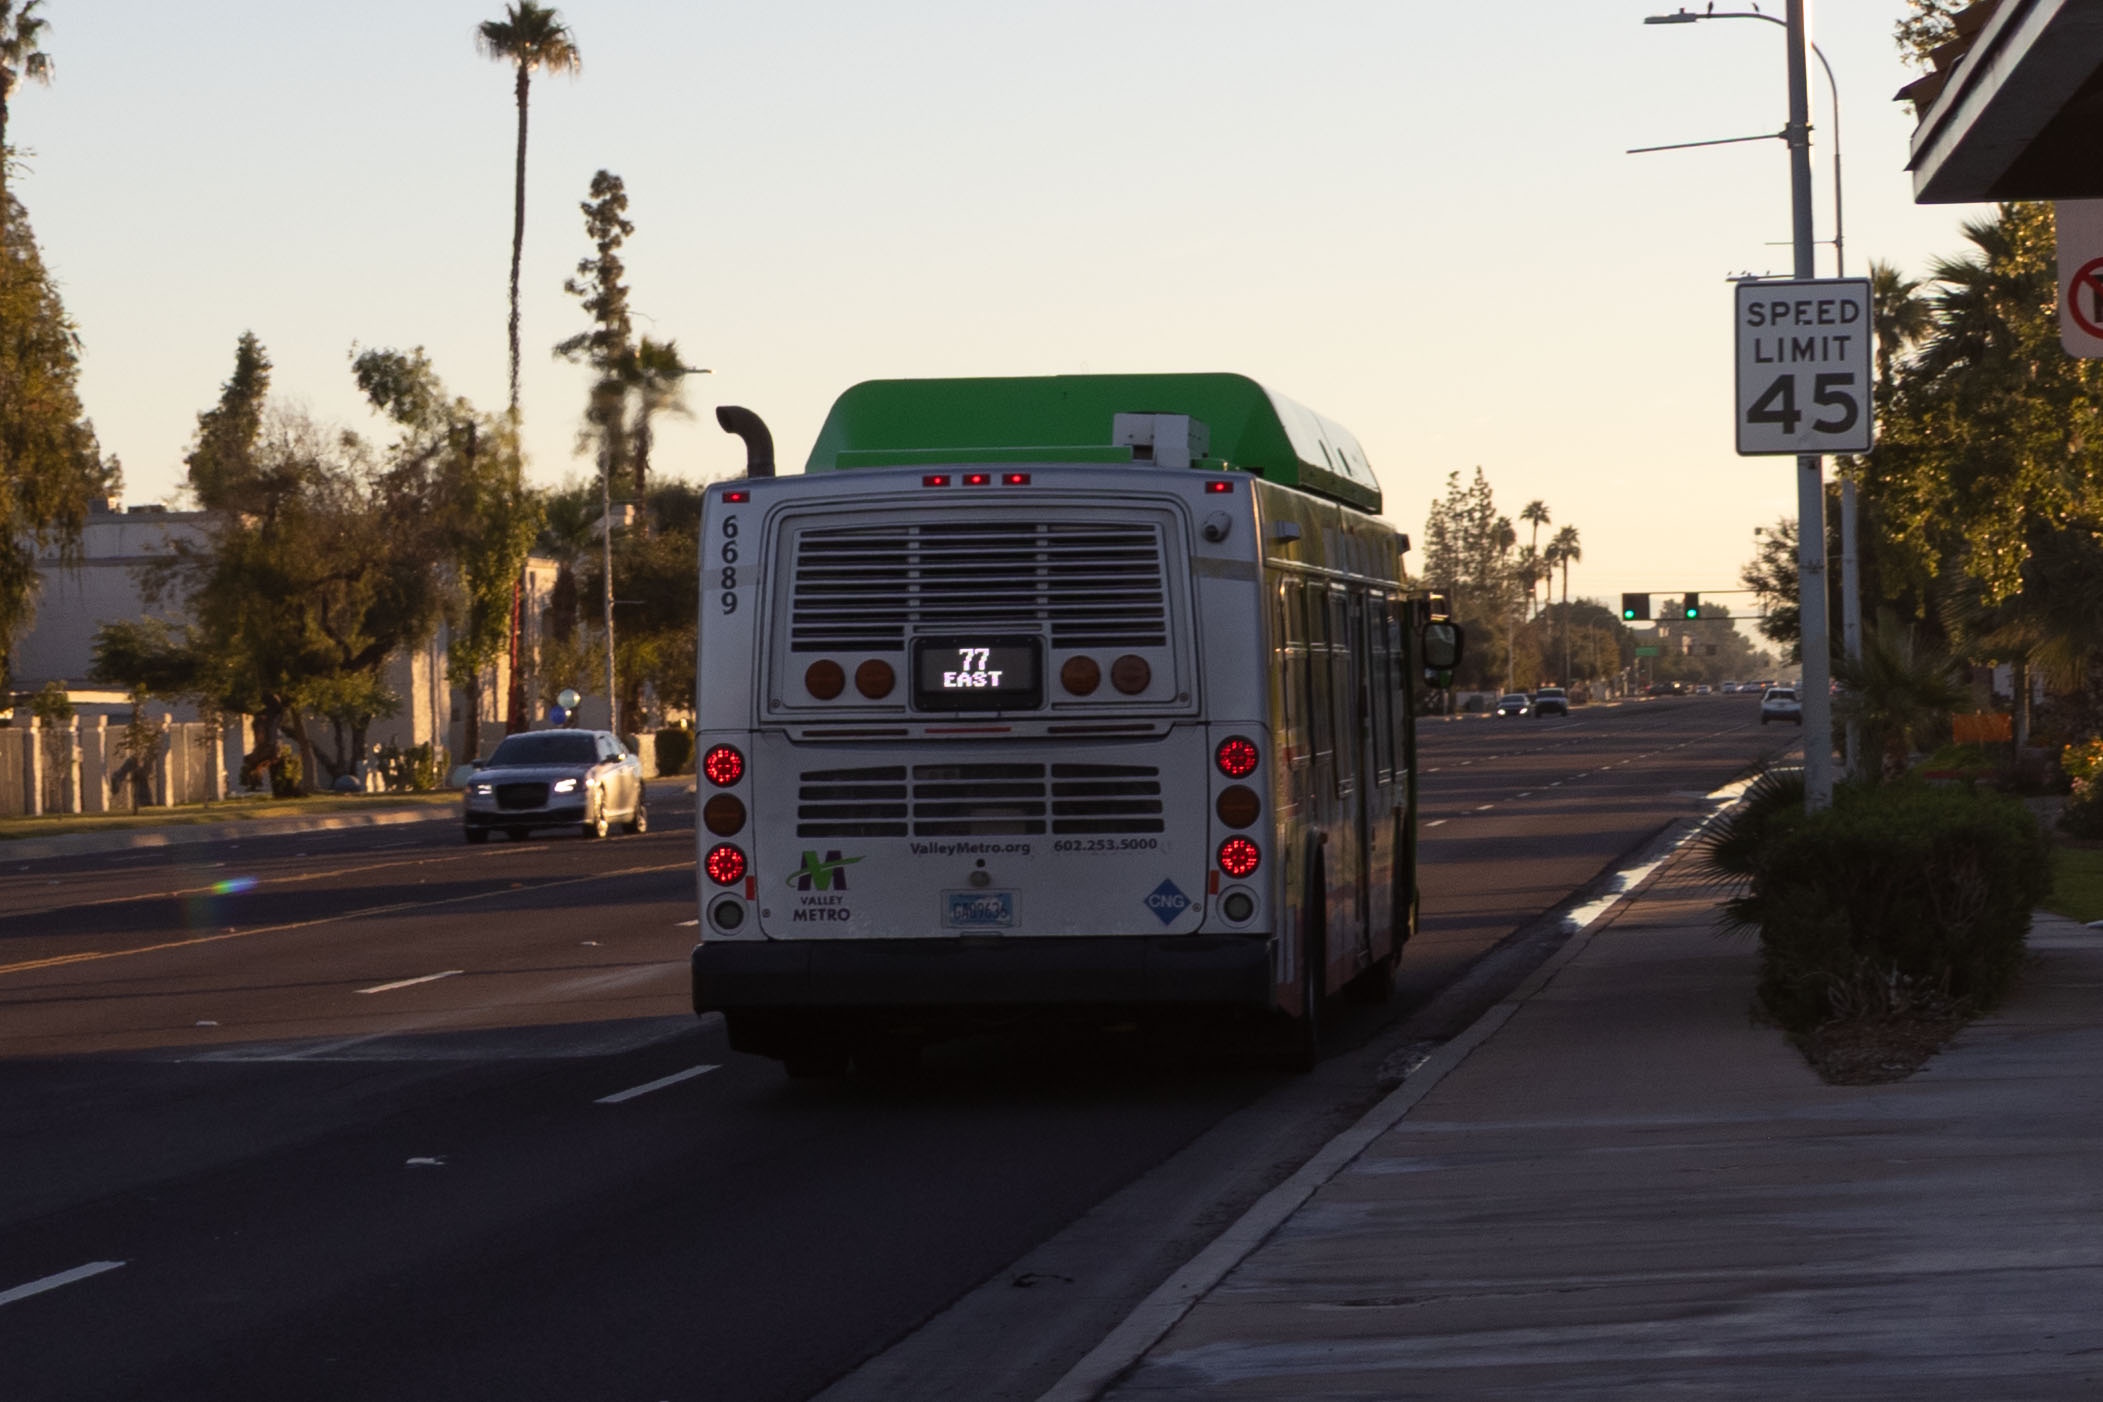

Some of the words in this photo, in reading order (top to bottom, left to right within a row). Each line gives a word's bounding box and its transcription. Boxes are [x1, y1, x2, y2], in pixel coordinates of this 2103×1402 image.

[1747, 299, 1860, 327] SPEED
[1754, 335, 1852, 364] LIMIT
[1746, 372, 1859, 435] 45
[721, 514, 739, 616] 6689
[958, 648, 990, 671] 77
[943, 670, 1003, 688] EAST
[910, 842, 1031, 856] ValleyMetro.org
[1054, 838, 1158, 852] 602.253.5000
[800, 895, 843, 906] VALLEY
[1148, 894, 1185, 908] CNG
[793, 908, 850, 922] METRO
